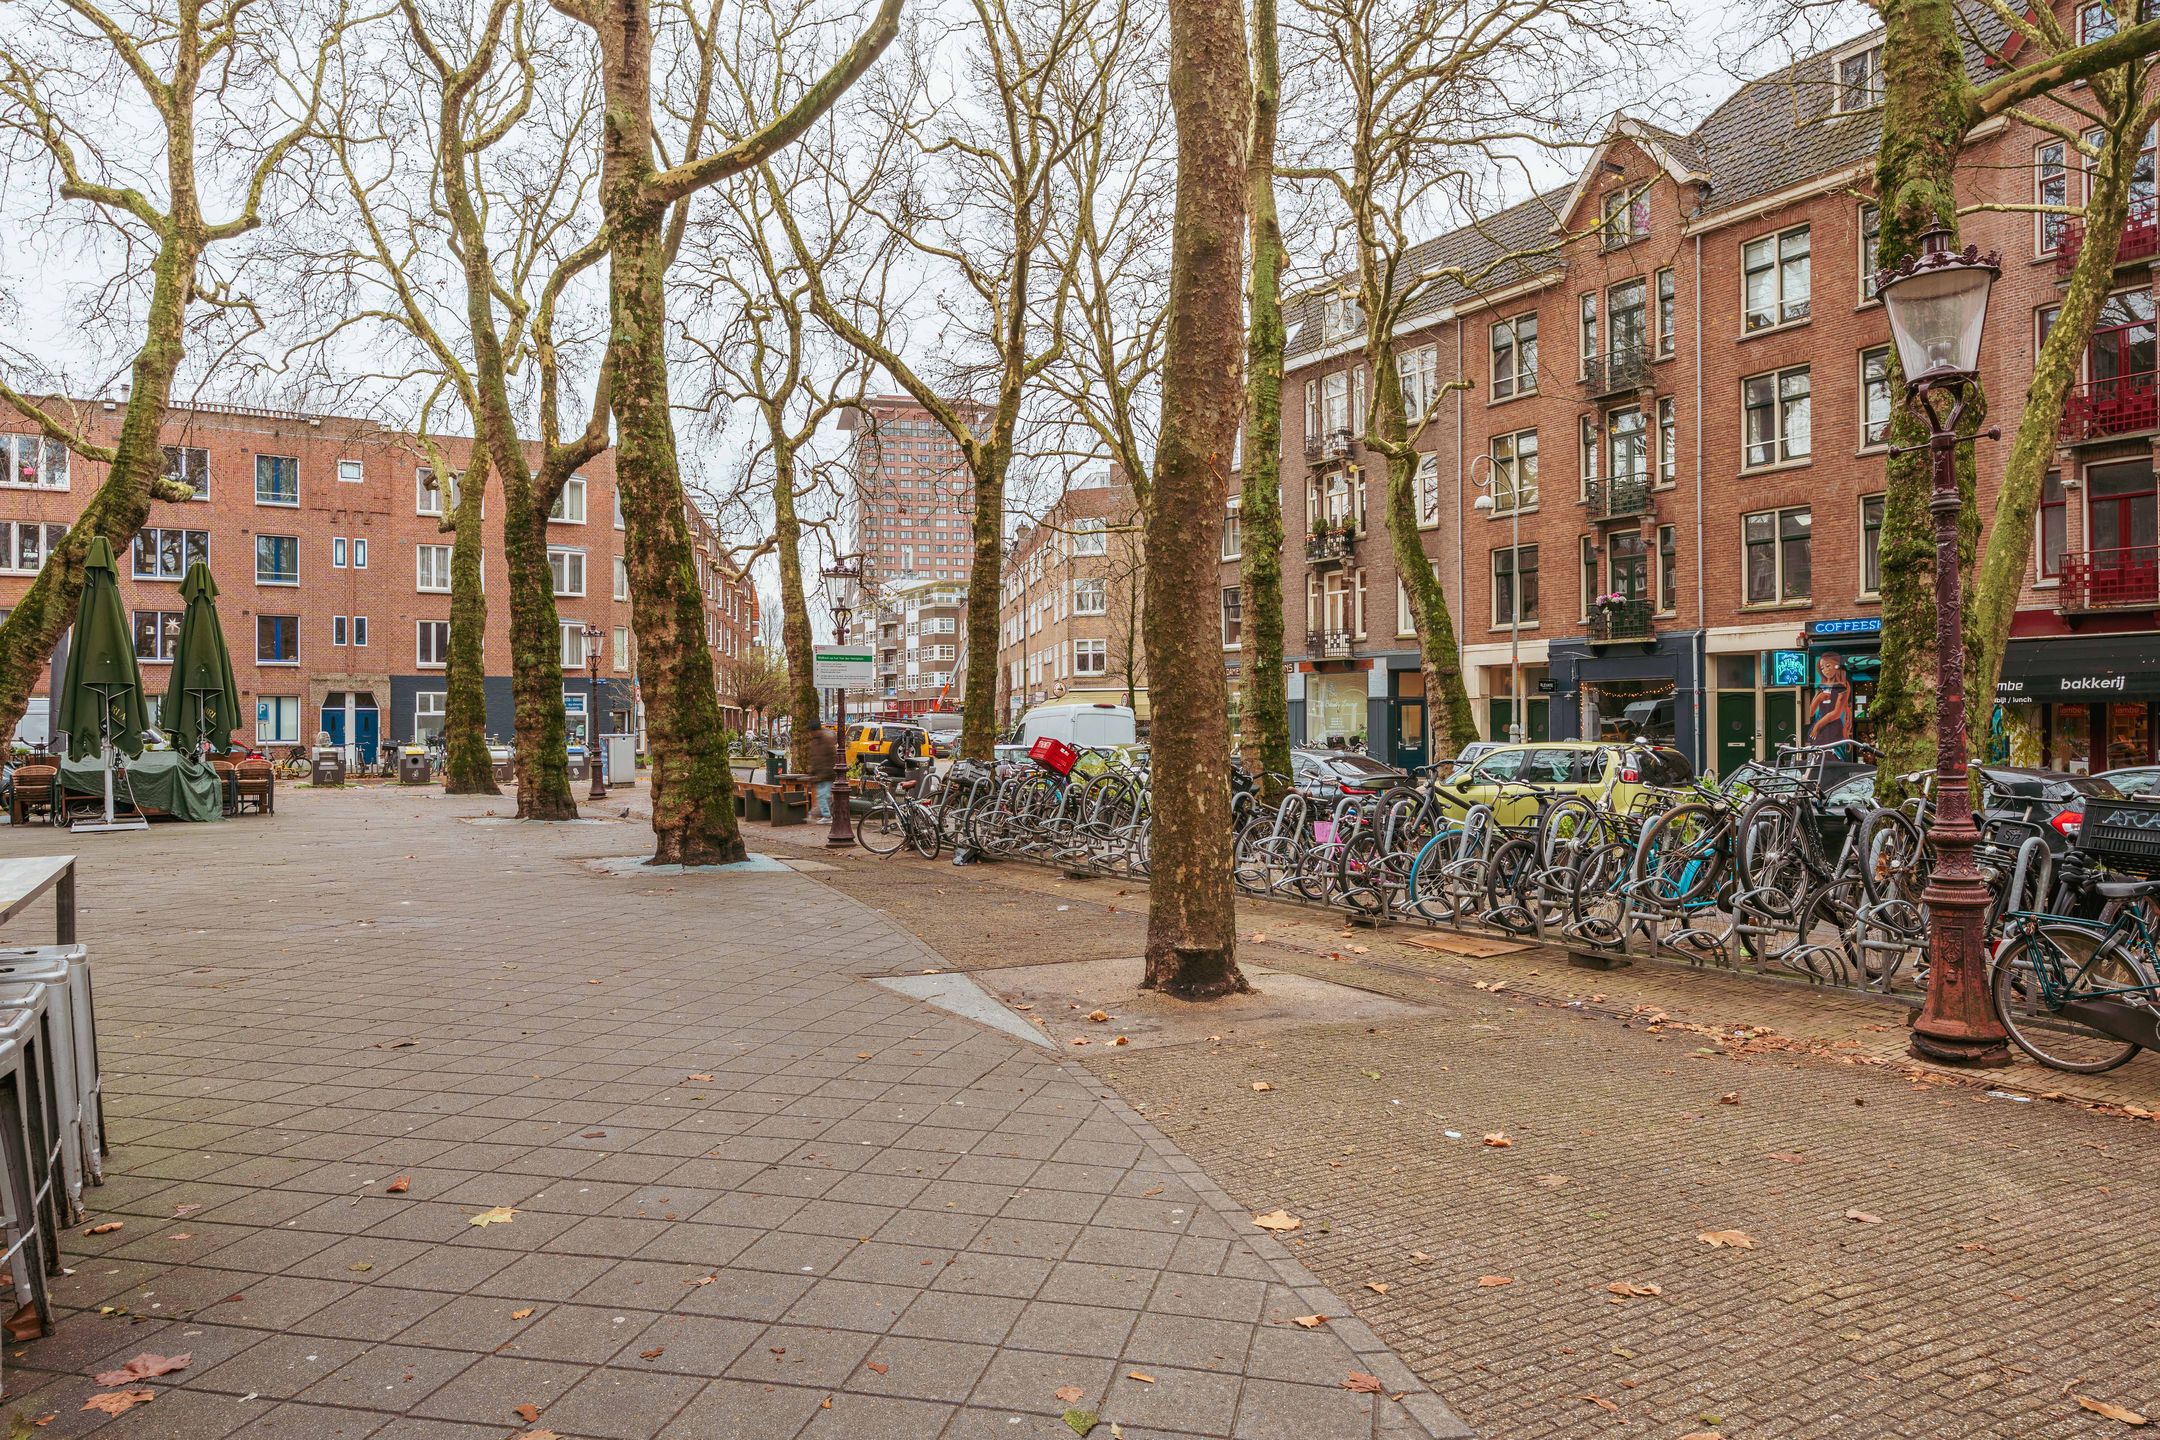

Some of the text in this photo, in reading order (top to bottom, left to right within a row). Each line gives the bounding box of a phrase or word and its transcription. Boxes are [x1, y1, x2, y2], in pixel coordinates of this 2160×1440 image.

[1815, 620, 1881, 633] COFFEES
[1996, 681, 2023, 691] mbe
[2061, 676, 2125, 690] bakkerij
[259, 704, 267, 715] P
